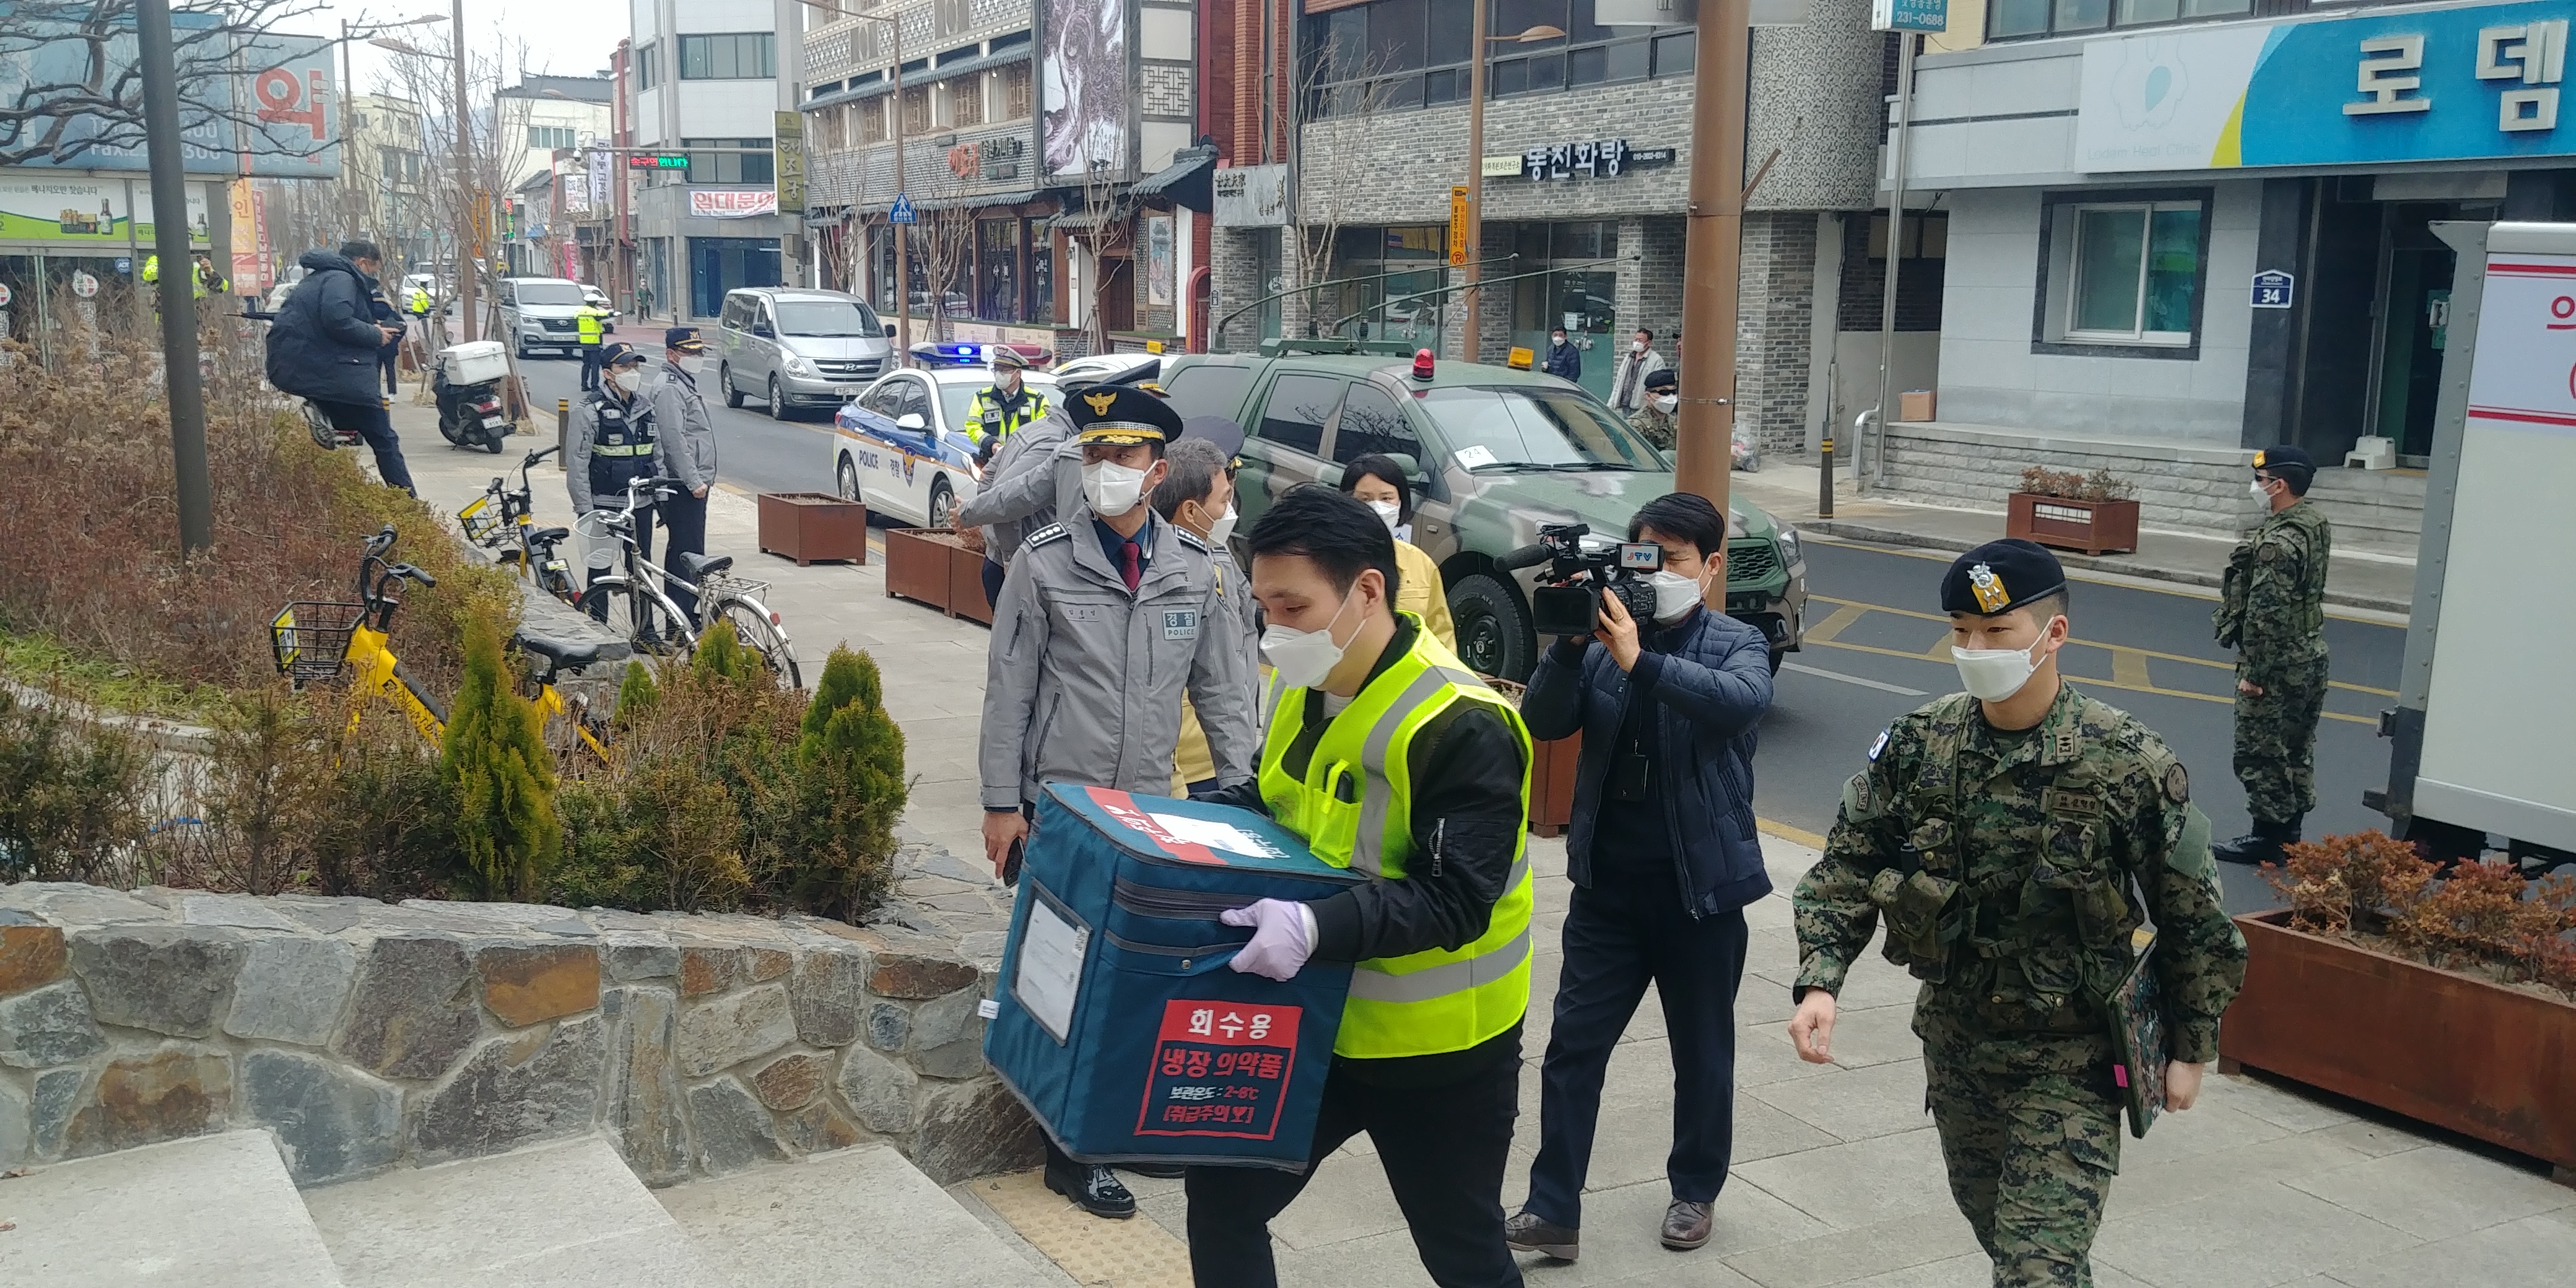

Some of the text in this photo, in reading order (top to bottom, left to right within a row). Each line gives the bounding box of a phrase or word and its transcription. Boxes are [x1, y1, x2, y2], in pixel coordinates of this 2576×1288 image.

[2343, 19, 2569, 132] 로뎀
[256, 69, 326, 141] 약
[1526, 139, 1625, 181] 동진화랑
[2261, 289, 2281, 303] 34
[859, 450, 879, 469] POLICE
[1464, 448, 1481, 458] 24
[890, 459, 900, 478] 경찰
[1627, 552, 1652, 561] JTV
[1167, 613, 1194, 627] 경찰
[1188, 1009, 1272, 1040] 회수용
[1161, 1048, 1284, 1079] 냉장 의약품
